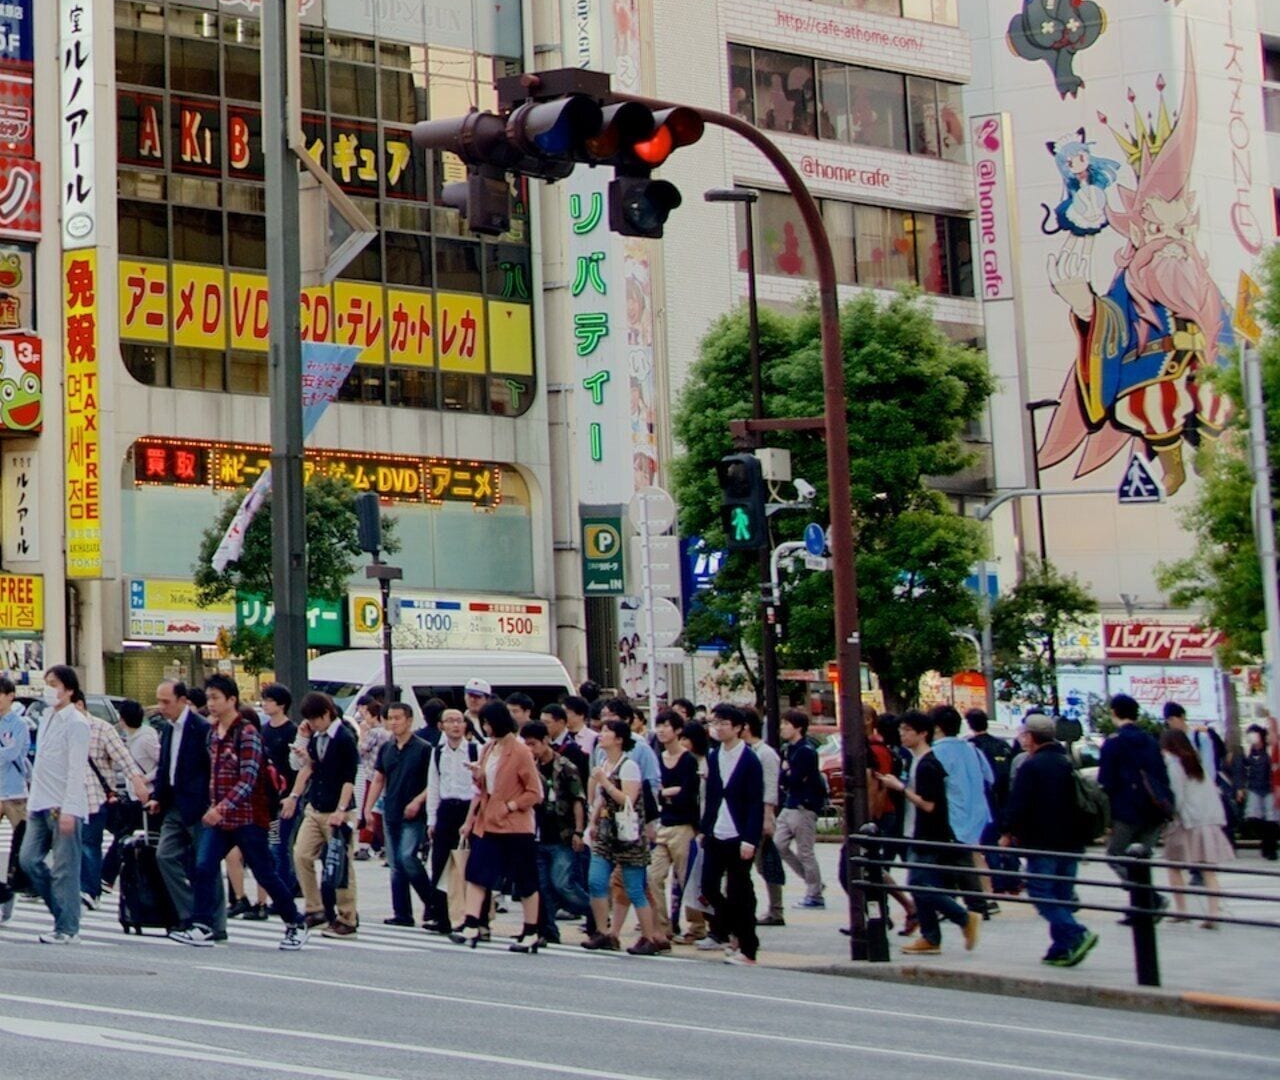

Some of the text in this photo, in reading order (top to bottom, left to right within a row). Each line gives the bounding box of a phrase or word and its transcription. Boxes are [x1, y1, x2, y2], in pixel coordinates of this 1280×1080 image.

[775, 8, 925, 53] http://cafe-athome.com/
[64, 39, 92, 205] ルノアール
[800, 154, 890, 190] @home cafe
[976, 158, 1001, 298] @home cafe
[65, 259, 96, 364] 免税
[570, 191, 609, 465] リバティー
[16, 341, 41, 365] 3F
[83, 372, 99, 520] TAX FREE
[144, 447, 492, 499] 買取 アニメ
[15, 471, 31, 556] ルノアール
[0, 576, 34, 604] FREE
[609, 578, 623, 590] IN
[416, 613, 452, 631] 1000
[497, 616, 533, 634] 1500
